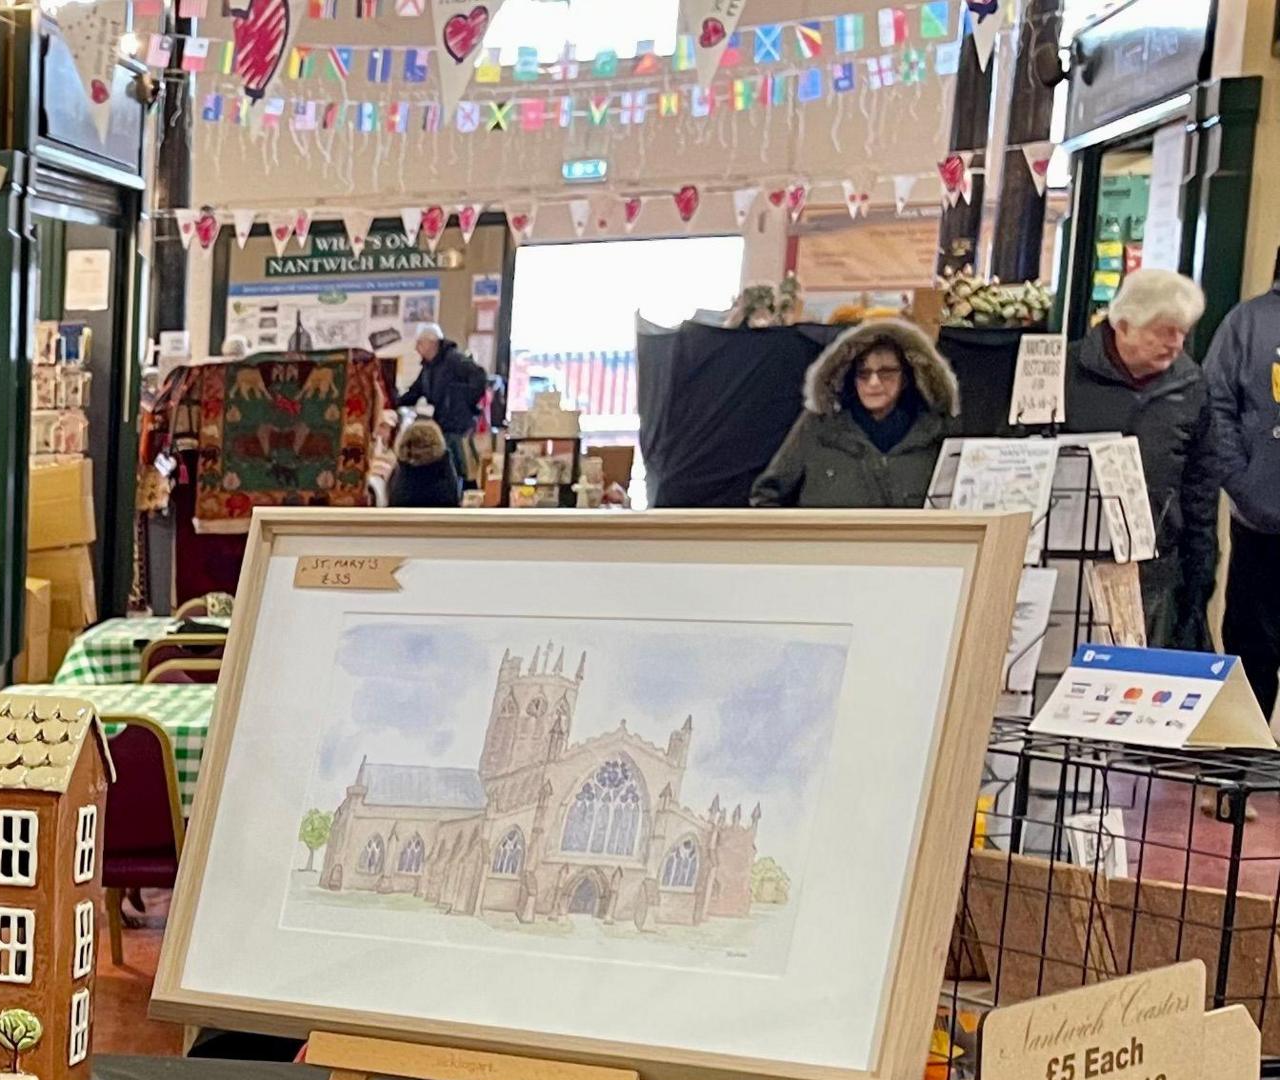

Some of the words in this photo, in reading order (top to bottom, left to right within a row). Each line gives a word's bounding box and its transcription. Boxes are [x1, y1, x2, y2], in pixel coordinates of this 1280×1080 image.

[268, 254, 374, 274] NANTWICH
[334, 558, 379, 570] MARY'S
[1118, 981, 1190, 1028] Coasters
[1084, 1036, 1144, 1080] Each
